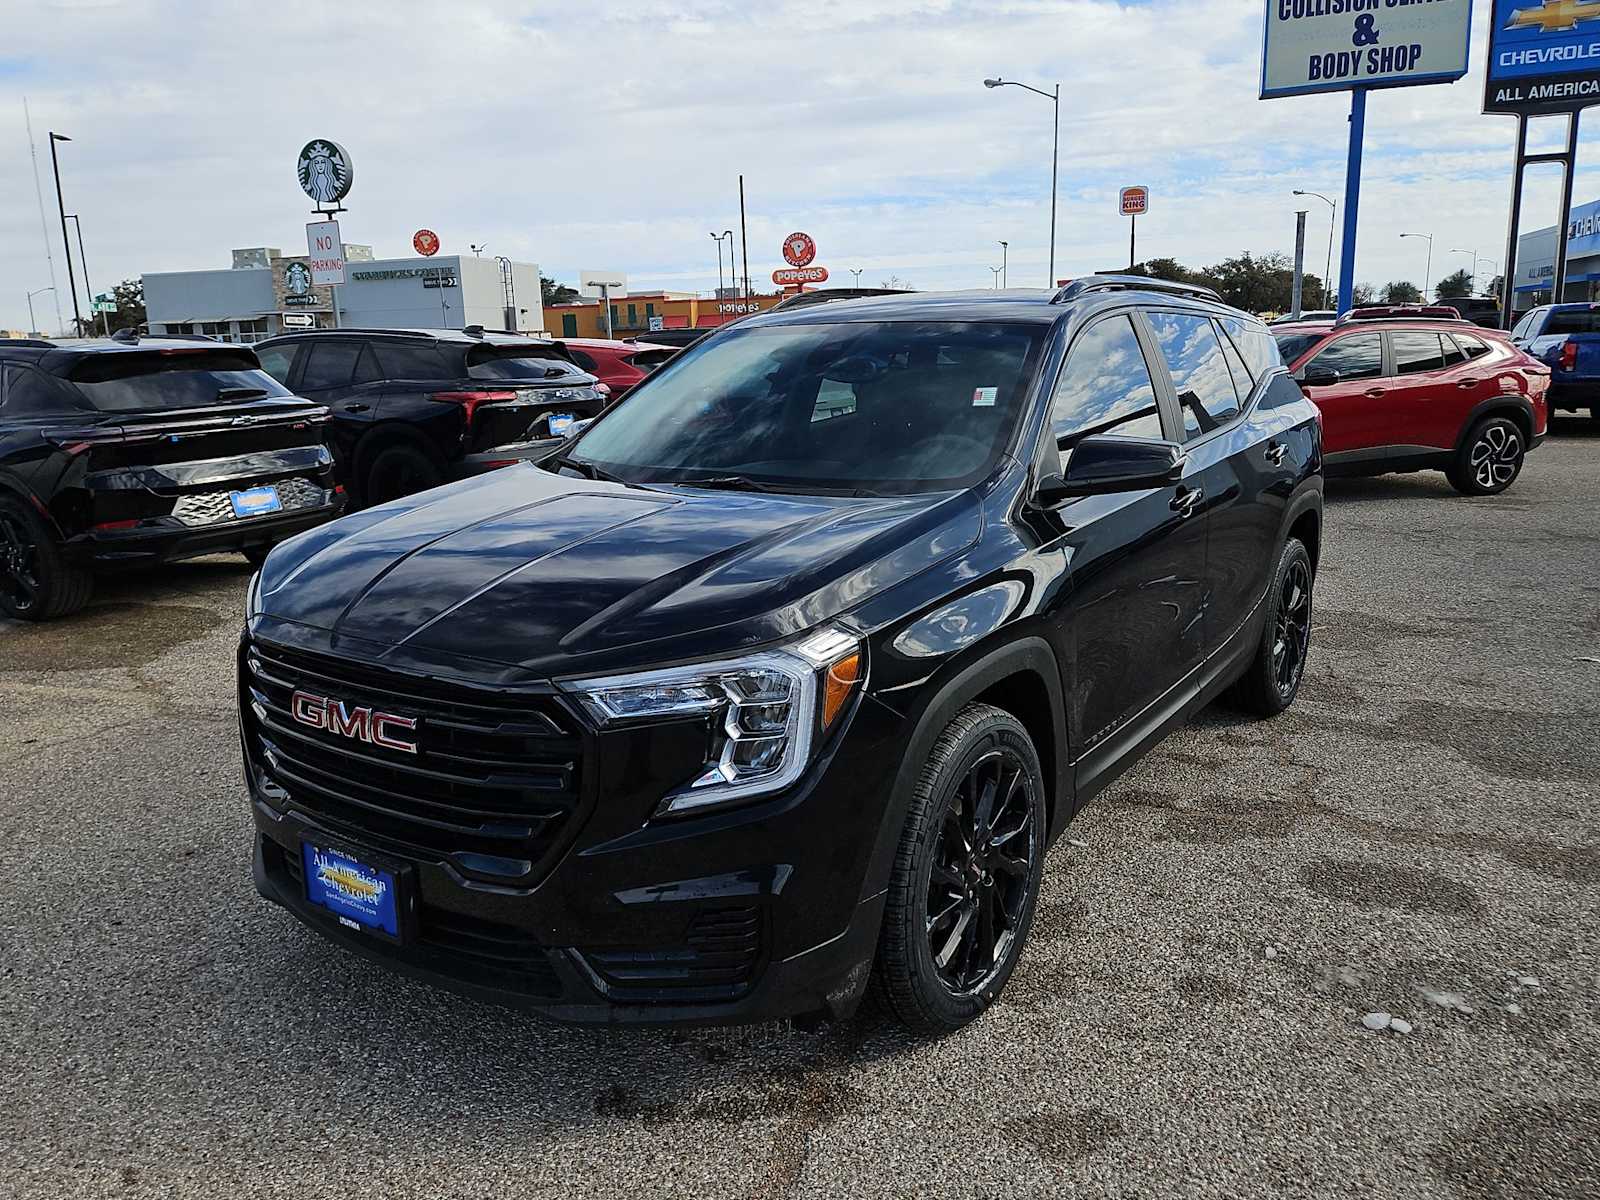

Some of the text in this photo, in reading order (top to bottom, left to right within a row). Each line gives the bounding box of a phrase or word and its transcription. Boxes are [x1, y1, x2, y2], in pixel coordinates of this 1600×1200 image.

[1352, 13, 1380, 47] &
[1308, 44, 1422, 81] BODY SHOP
[1500, 43, 1600, 67] CHEVROLE
[1495, 80, 1600, 102] ALL AMERICA
[1122, 200, 1145, 209] KING
[1576, 214, 1600, 237] CHEVR
[315, 236, 333, 251] NO
[311, 258, 343, 272] PARKING
[292, 690, 418, 754] GMC
[313, 853, 387, 893] All American
[322, 874, 379, 906] Chevrolet
